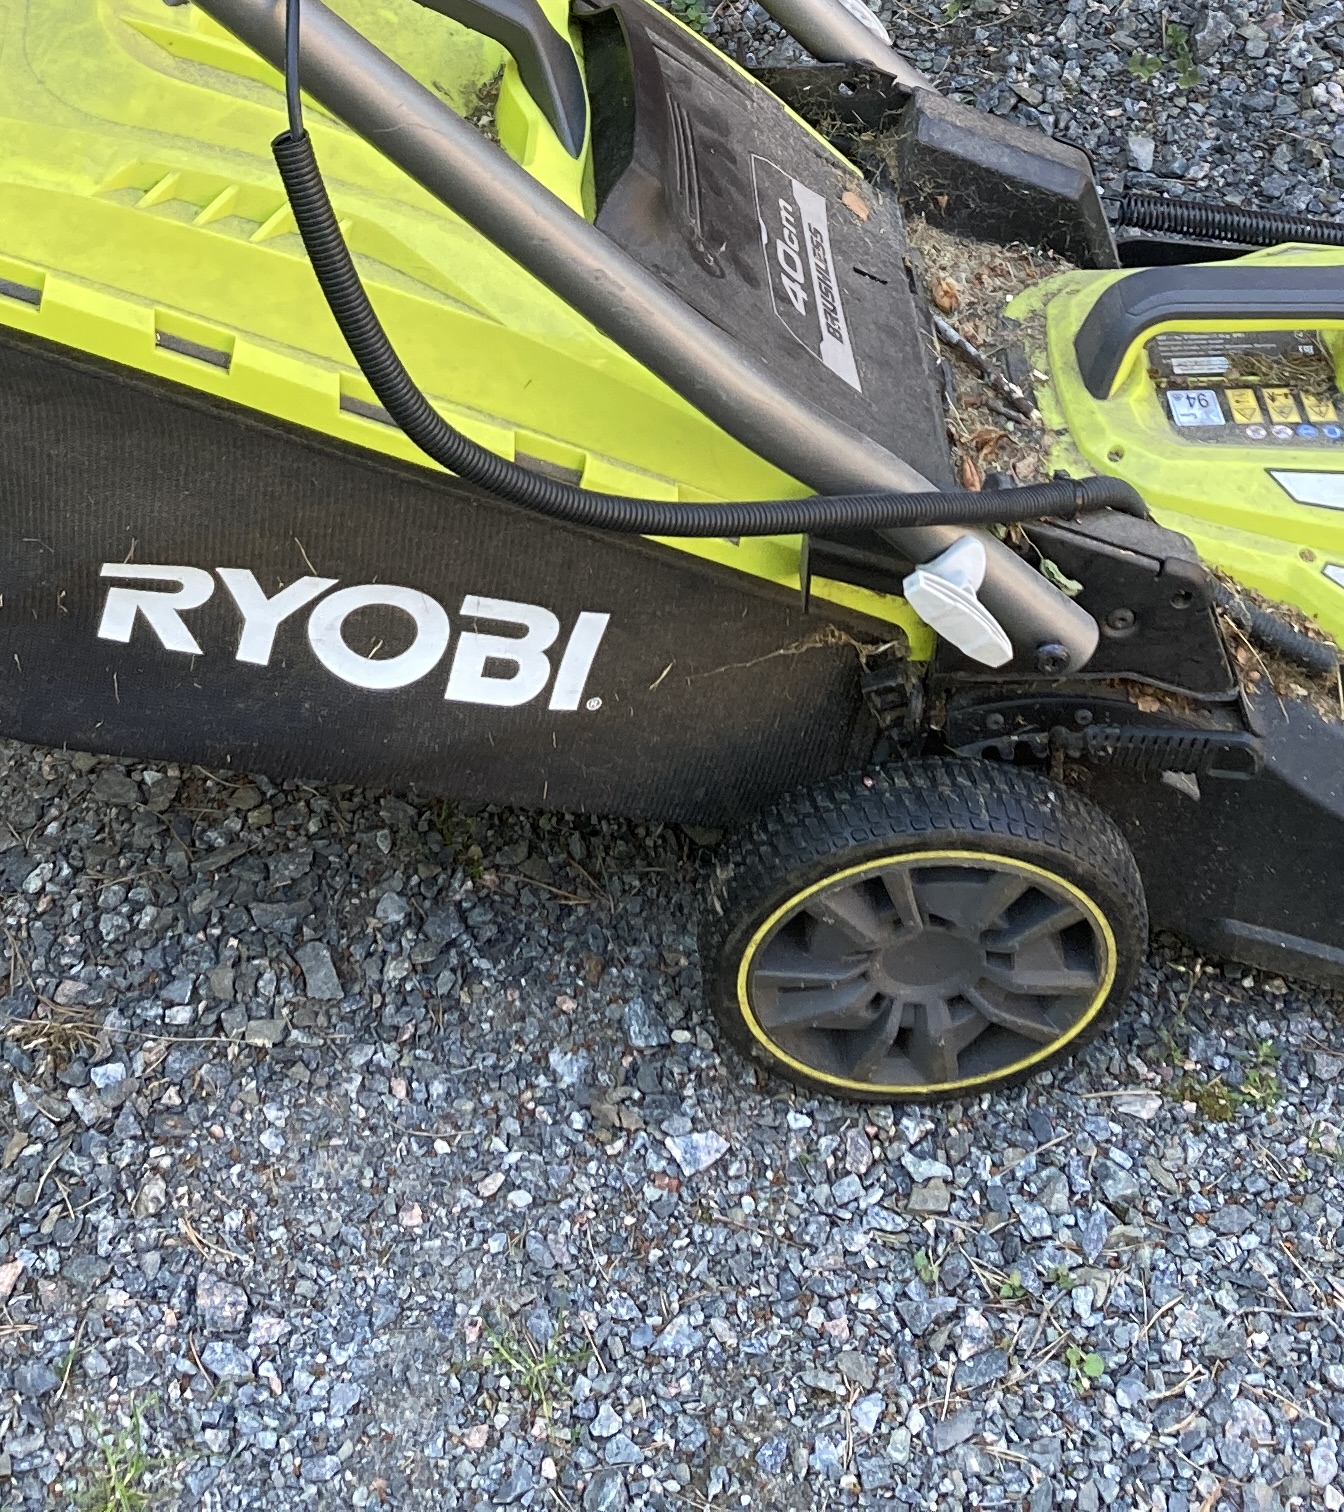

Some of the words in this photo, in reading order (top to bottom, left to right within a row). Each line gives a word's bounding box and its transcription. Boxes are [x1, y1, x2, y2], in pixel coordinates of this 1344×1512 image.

[776, 198, 808, 316] 40cm
[807, 222, 844, 344] BRUSHLESS
[1186, 392, 1209, 408] 94
[97, 562, 611, 711] RYOBI
